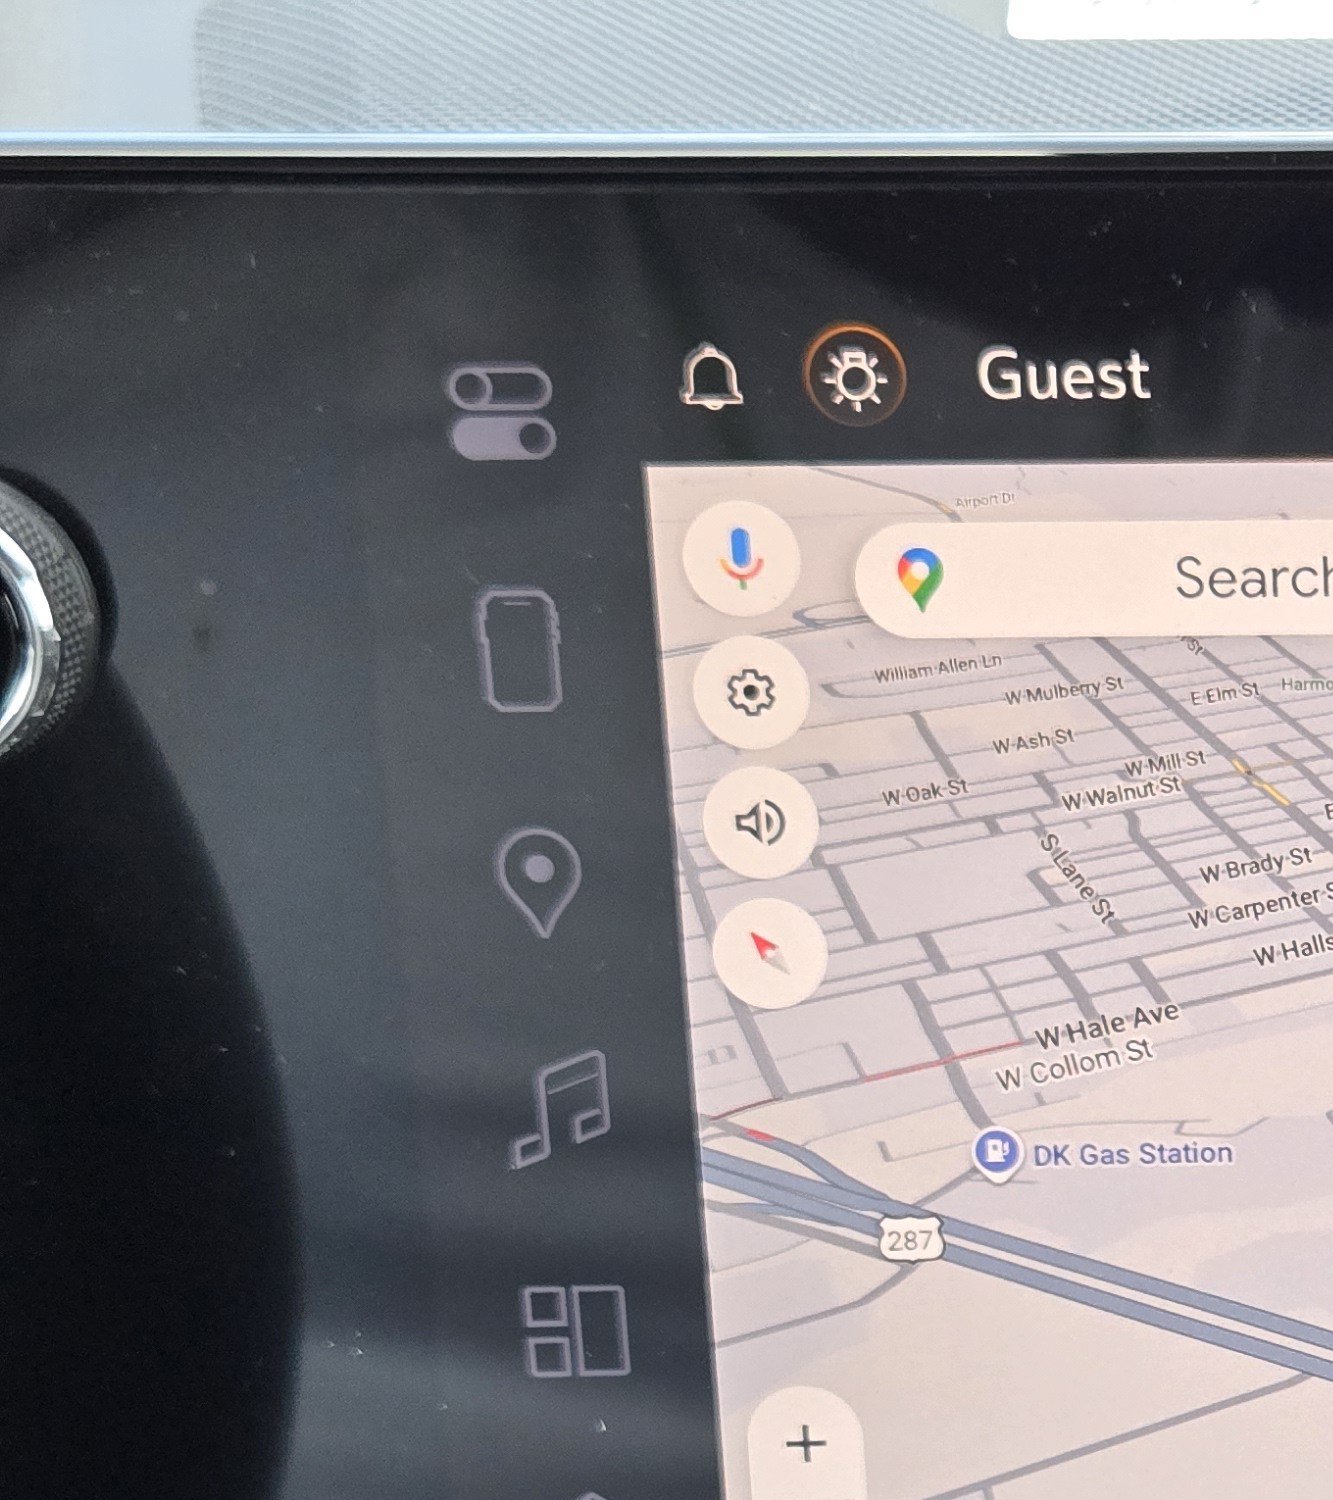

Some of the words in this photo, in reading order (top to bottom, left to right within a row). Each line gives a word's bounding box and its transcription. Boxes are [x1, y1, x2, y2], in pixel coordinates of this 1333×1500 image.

[978, 346, 1151, 399] Guest
[874, 660, 933, 684] William
[939, 656, 979, 676] Allen
[983, 654, 1002, 669] Ln
[1006, 689, 1022, 706] W
[1023, 678, 1102, 703] Mulberry
[1105, 676, 1123, 694] St
[1190, 691, 1203, 706] E
[1206, 686, 1238, 704] Elm
[1242, 682, 1260, 698] St
[992, 738, 1010, 755] W
[1013, 731, 1050, 751] Ash
[1054, 728, 1075, 747] St
[1124, 760, 1144, 777] W
[1148, 751, 1183, 775] Mill
[1186, 748, 1206, 769] St
[883, 790, 900, 807] W
[906, 782, 943, 804] Oak
[948, 778, 968, 798] St
[1062, 794, 1082, 811] W
[1083, 781, 1156, 808] Walnut
[1161, 777, 1181, 796] St
[1040, 833, 1059, 854] S
[1057, 850, 1098, 904] Lane
[1092, 897, 1115, 924] St
[1201, 864, 1220, 883] W
[1226, 851, 1284, 879] Brady
[1290, 847, 1312, 865] St
[1189, 910, 1209, 929] W
[1215, 888, 1319, 925] Carpenter
[1254, 947, 1276, 966] W
[1035, 1026, 1059, 1050] W
[1065, 1012, 1126, 1044] Hale
[1134, 1002, 1179, 1030] Ave
[996, 1067, 1021, 1091] W
[1029, 1048, 1121, 1084] Collom
[1125, 1039, 1154, 1063] St
[1034, 1143, 1070, 1167] DK
[1079, 1142, 1131, 1167] Gas
[1138, 1141, 1233, 1165] Station
[887, 1231, 933, 1252] 287
